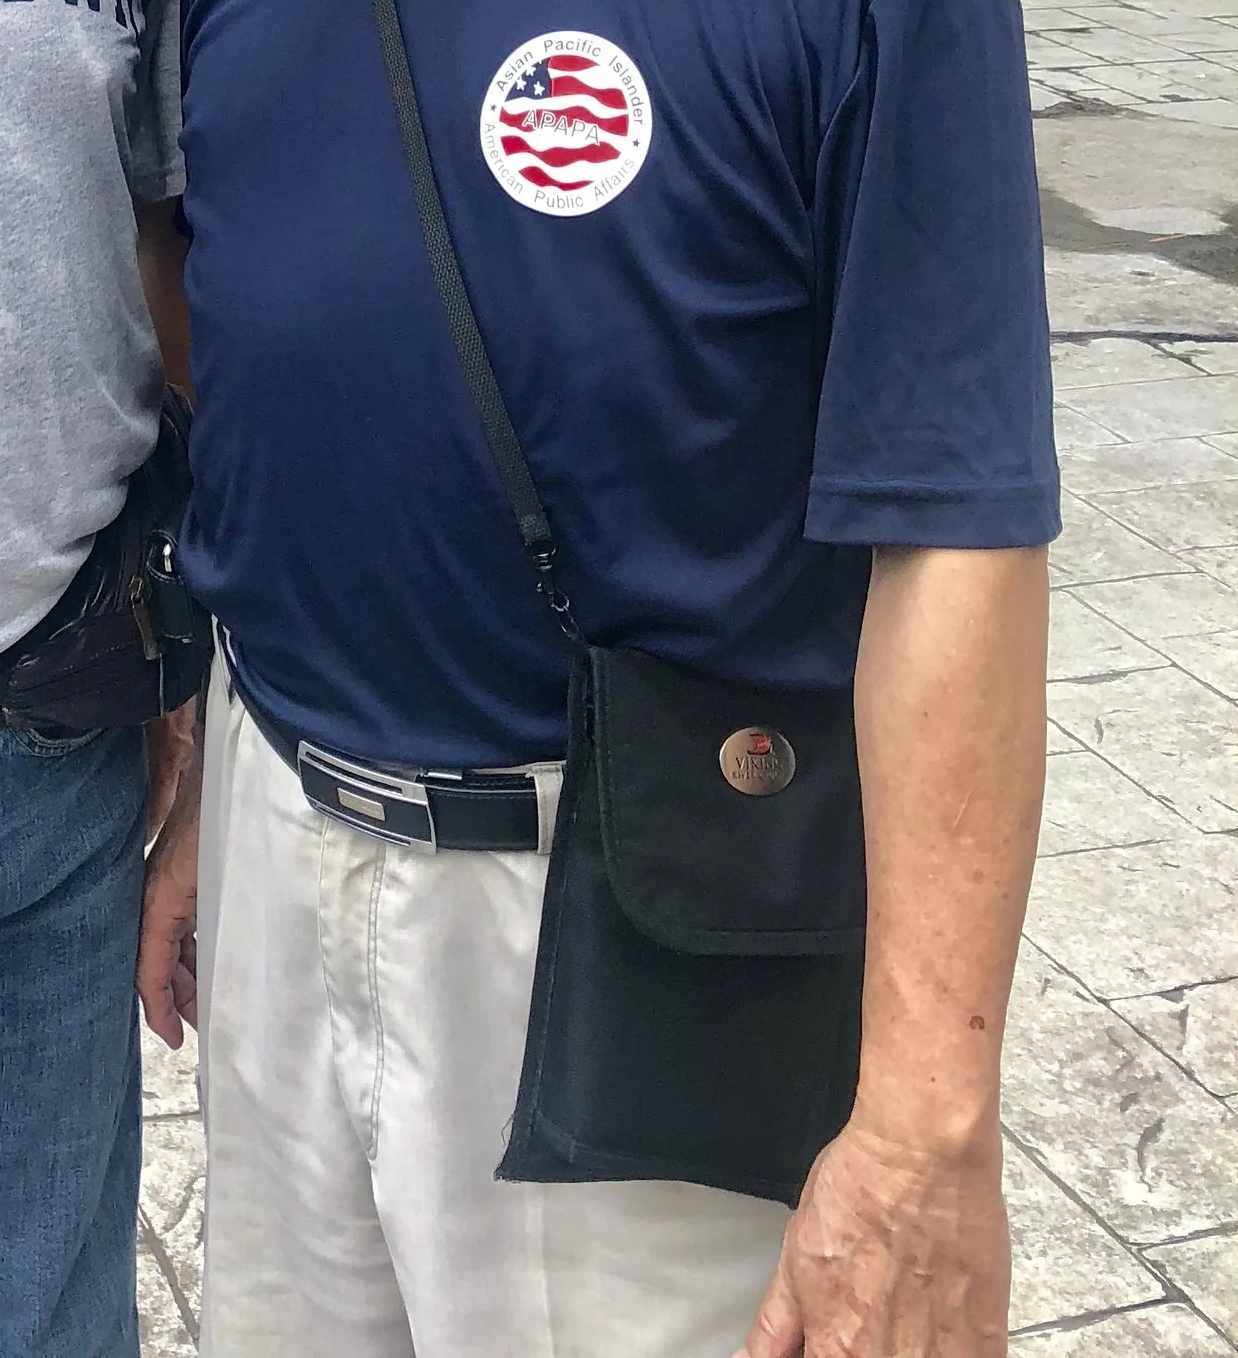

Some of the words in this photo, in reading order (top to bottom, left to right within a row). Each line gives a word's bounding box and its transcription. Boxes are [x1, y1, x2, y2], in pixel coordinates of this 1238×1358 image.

[496, 51, 534, 93] Asian
[543, 38, 602, 58] Pacific
[608, 55, 645, 126] Islander
[484, 122, 525, 195] American
[533, 189, 585, 210] Public
[593, 157, 636, 201] Affairs
[522, 109, 601, 145] APAPA
